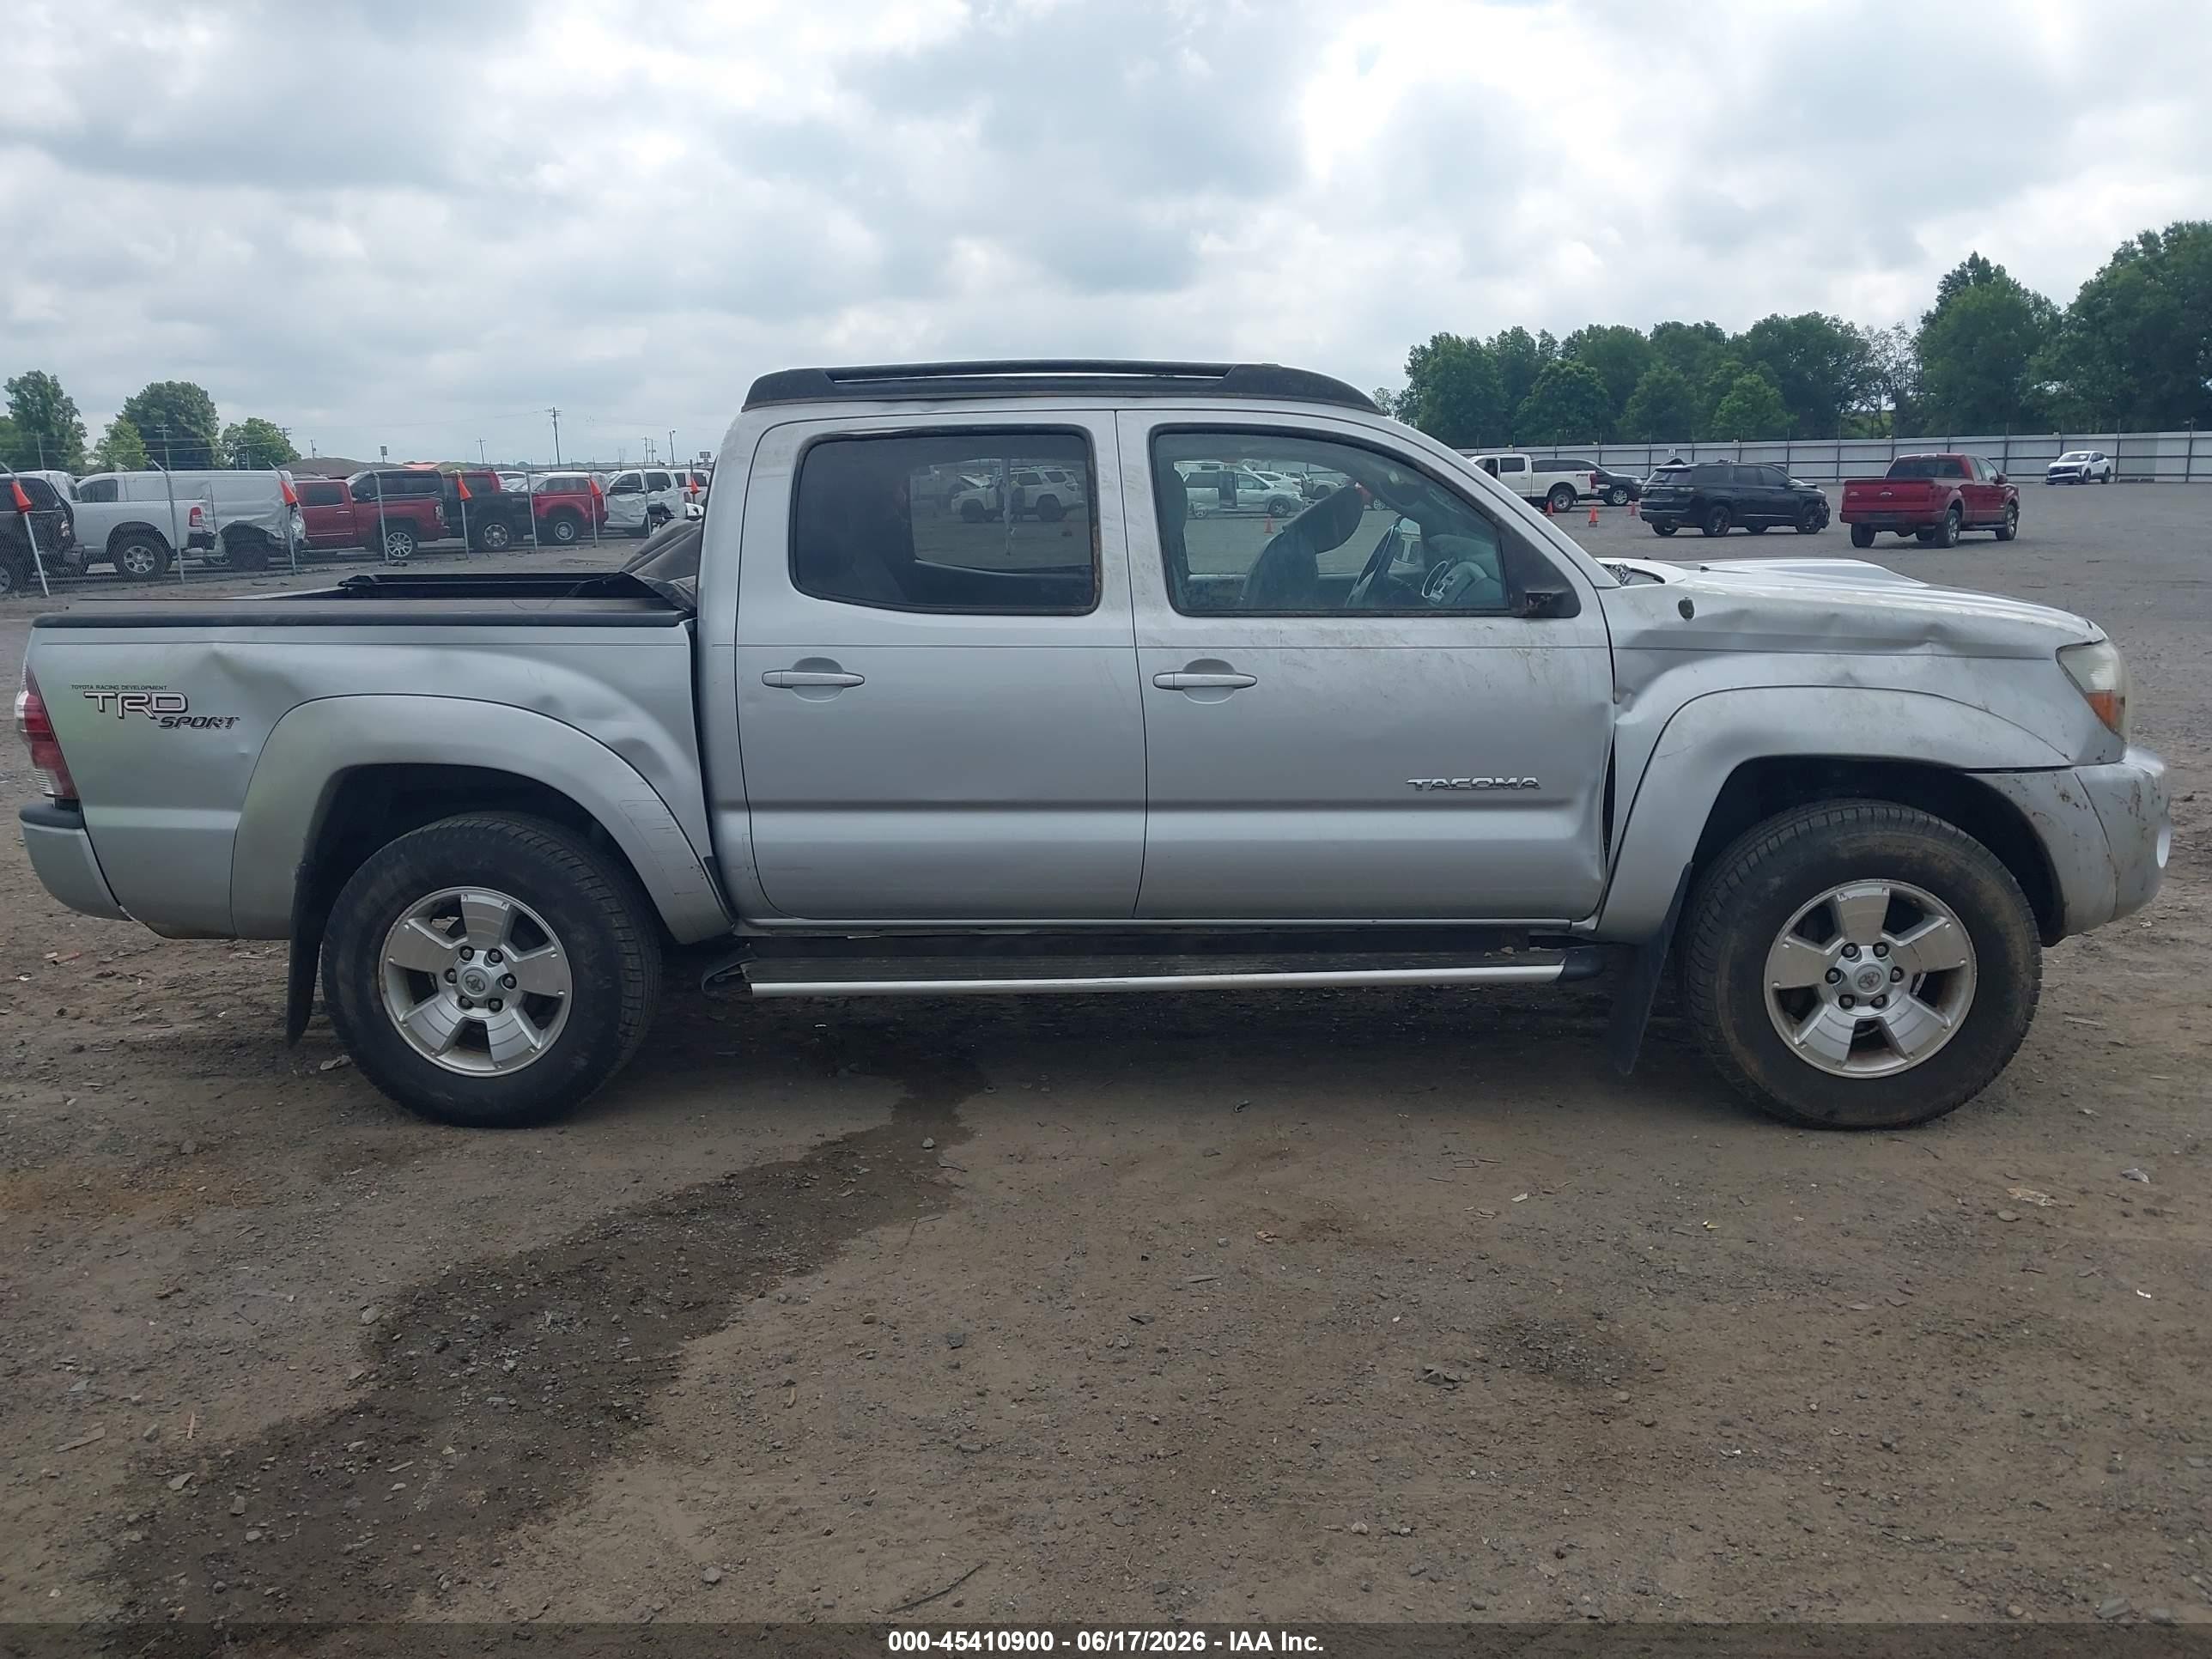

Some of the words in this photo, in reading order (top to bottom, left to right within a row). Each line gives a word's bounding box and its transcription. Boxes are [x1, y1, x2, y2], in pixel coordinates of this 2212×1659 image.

[83, 690, 189, 720] TRD
[157, 716, 241, 730] SPORT
[1405, 776, 1541, 791] TACOMA
